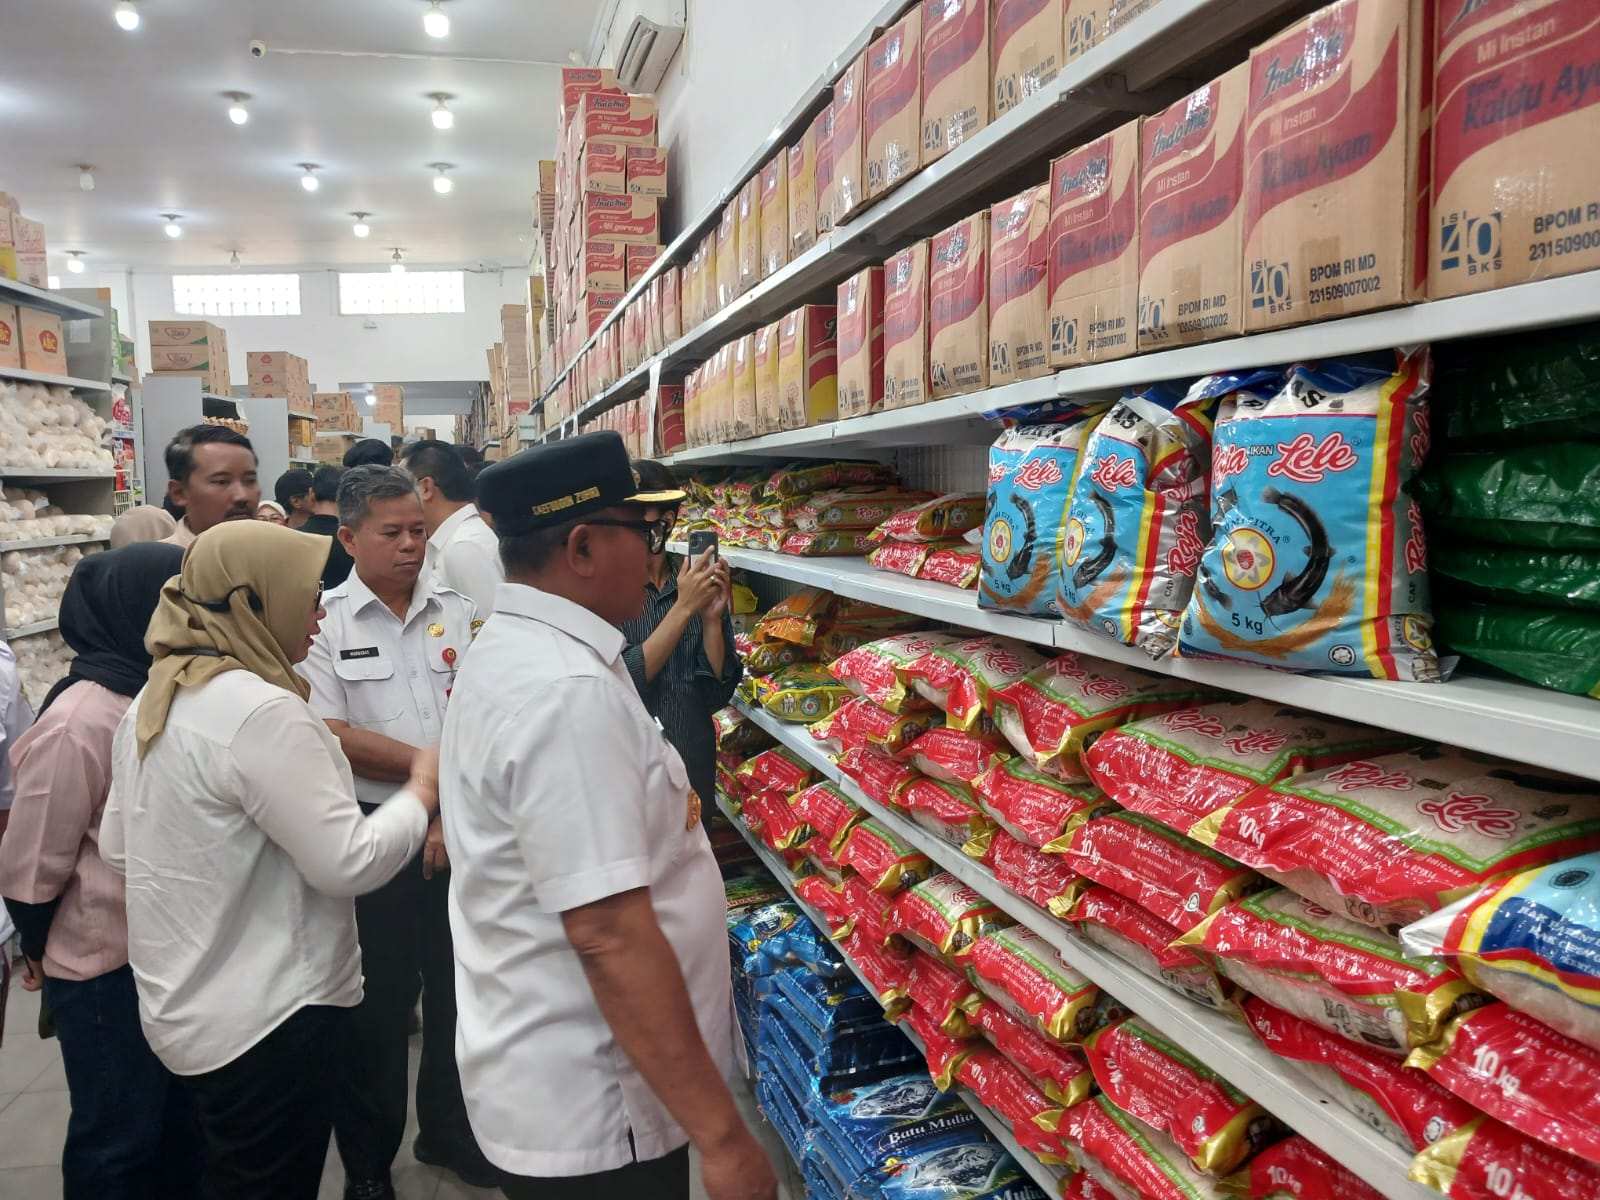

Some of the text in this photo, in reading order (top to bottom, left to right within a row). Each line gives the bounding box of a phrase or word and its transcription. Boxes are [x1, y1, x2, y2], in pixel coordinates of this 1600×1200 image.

[1477, 18, 1556, 64] Mi Instan
[1283, 106, 1317, 132] Instan
[1441, 210, 1467, 226] ISI
[1533, 205, 1582, 235] BPOM
[1440, 211, 1503, 271] 40
[1310, 253, 1377, 283] BPOM RI MD
[1468, 259, 1503, 277] BKS
[1251, 262, 1291, 309] 40
[1309, 275, 1382, 304] 231509007002
[1178, 300, 1201, 317] BPOM
[1212, 294, 1227, 308] MD
[1269, 301, 1293, 314] BKS
[1052, 317, 1078, 353] 40
[1091, 453, 1138, 492] Lele
[1267, 431, 1359, 484] Lele
[1014, 457, 1063, 490] Lele
[1167, 509, 1205, 577] Raja
[1231, 613, 1263, 635] 5 kg
[1416, 791, 1521, 840] Lele
[1473, 1043, 1521, 1098] 10 kg
[888, 1124, 926, 1146] Batu
[1267, 1164, 1288, 1185] 10
[1484, 1161, 1513, 1197] 10
